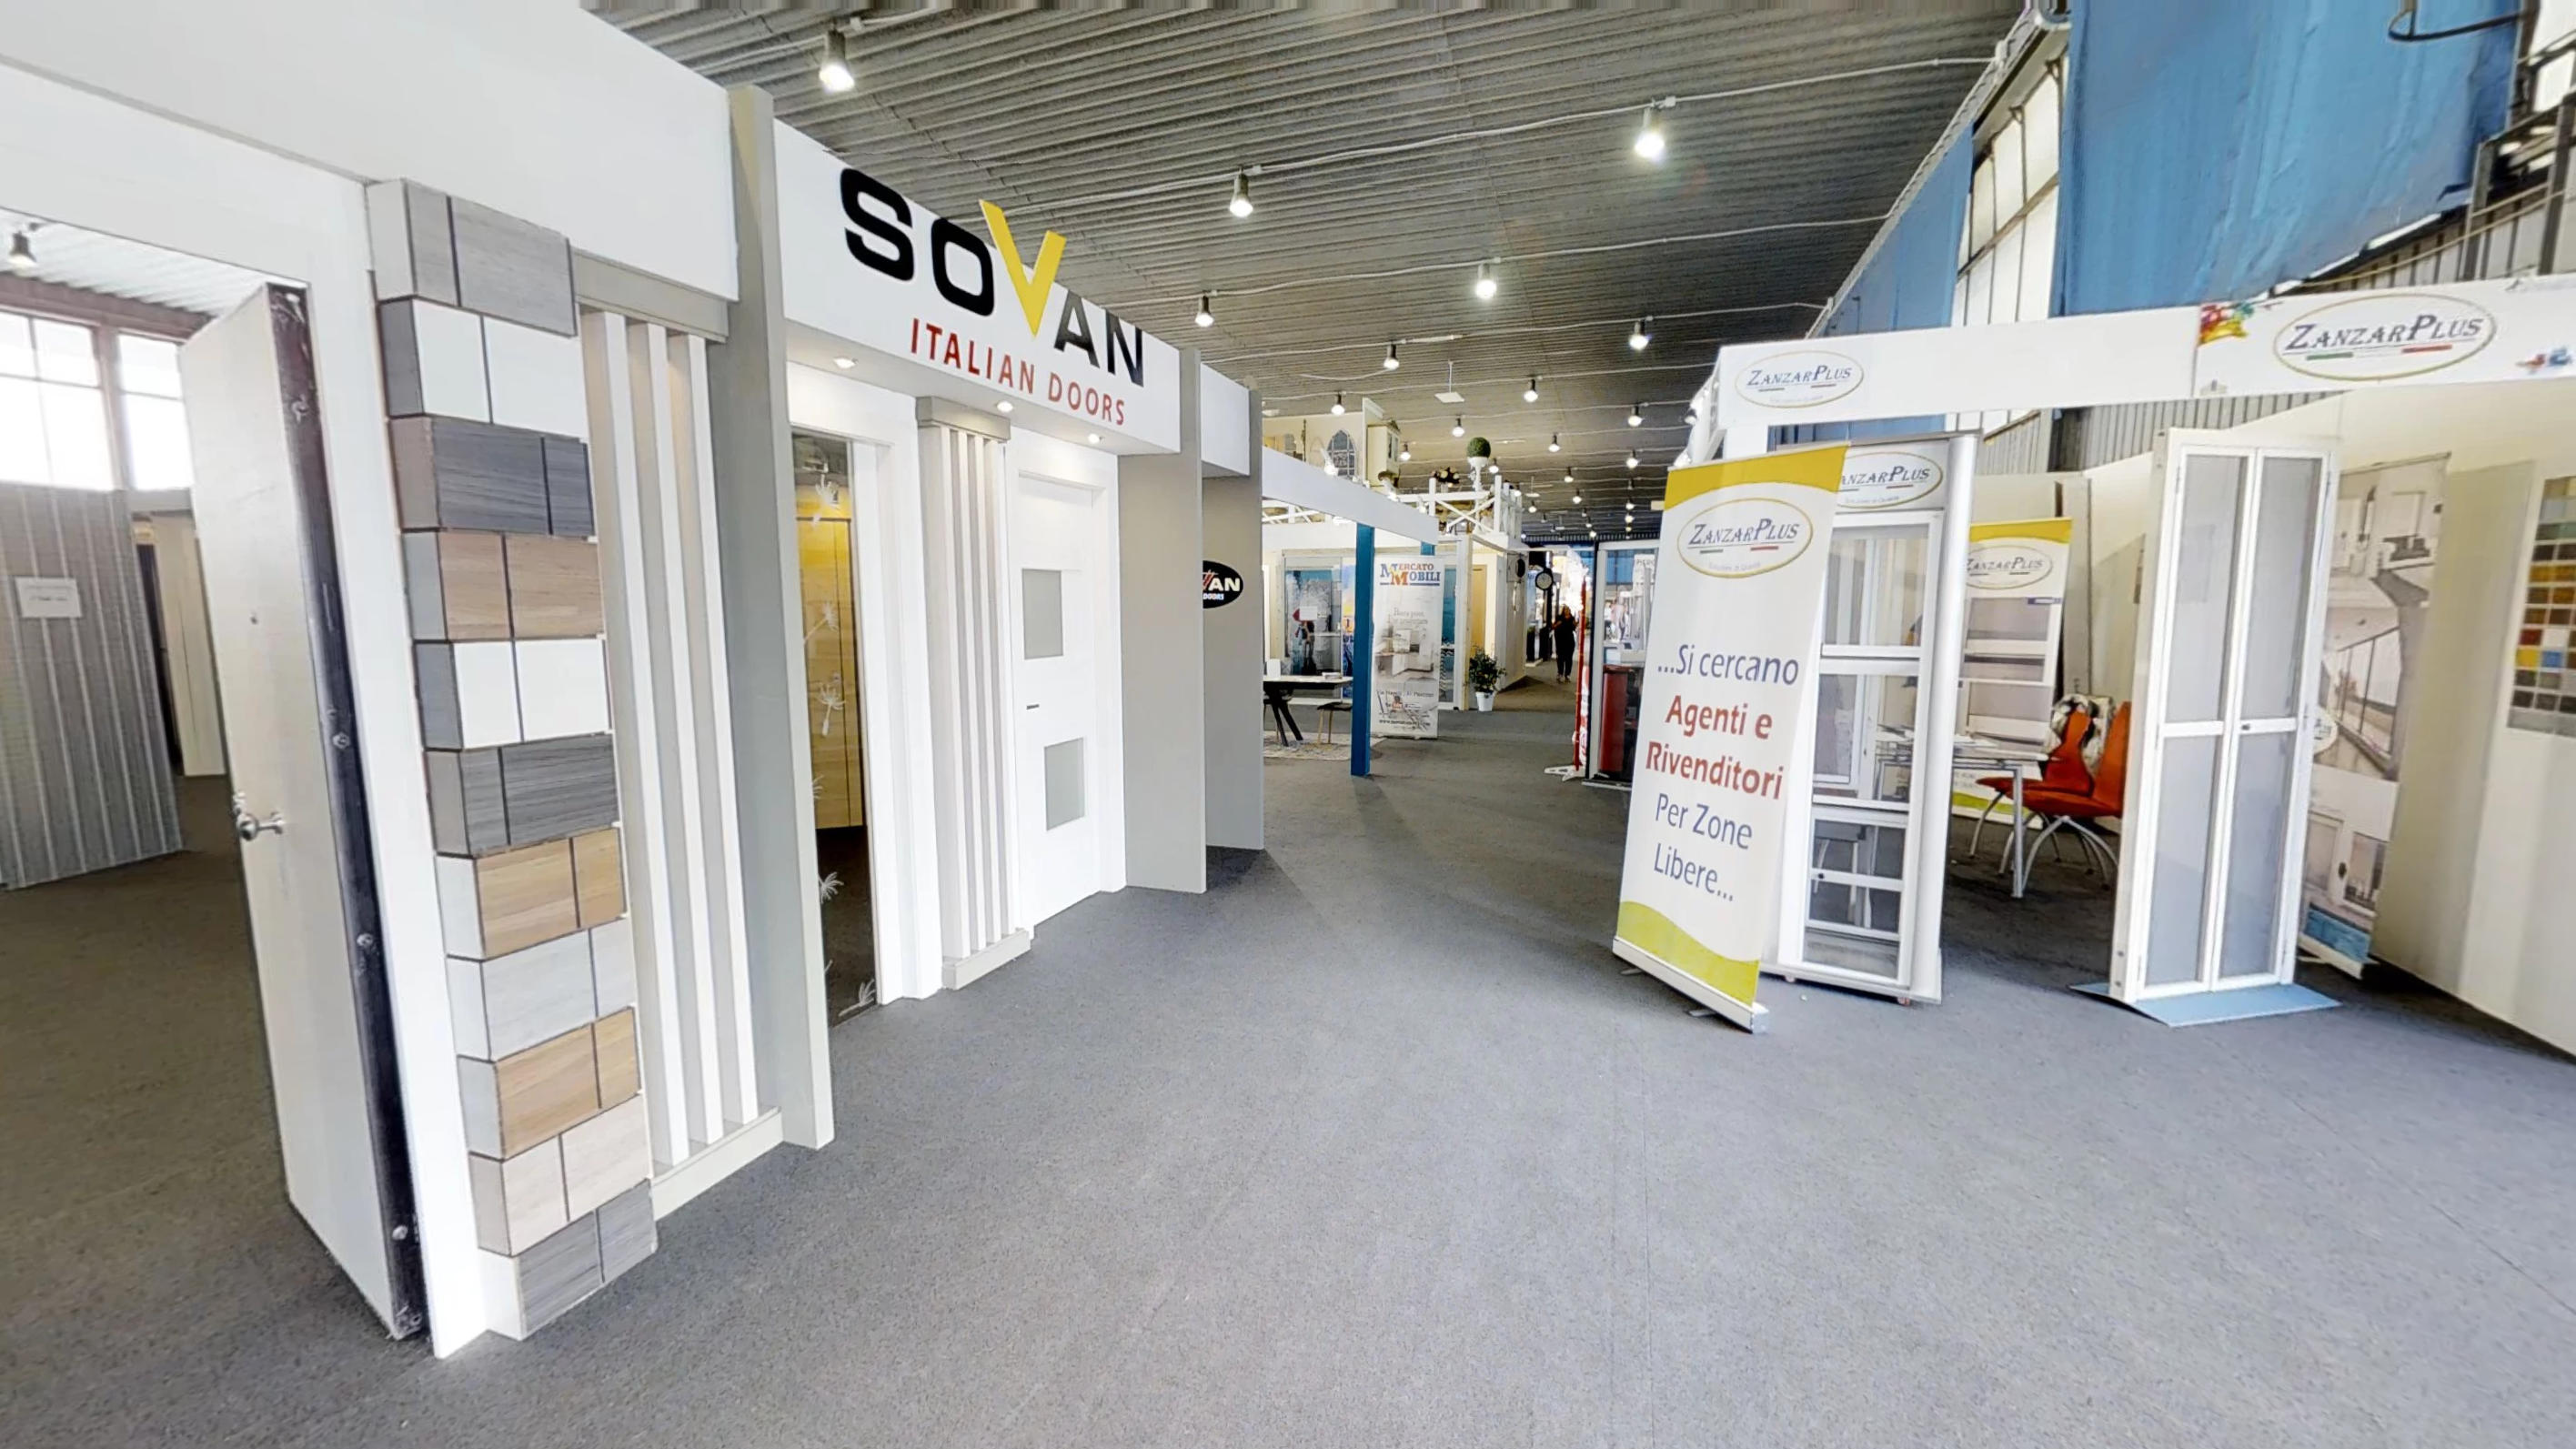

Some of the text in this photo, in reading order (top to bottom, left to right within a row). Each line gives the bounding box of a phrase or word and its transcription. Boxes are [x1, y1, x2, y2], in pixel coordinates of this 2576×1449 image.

[840, 167, 1144, 387] SOVAN
[911, 317, 1126, 426] ITALIAN DOORS
[1380, 563, 1434, 578] MERCATO
[1390, 571, 1442, 585] MOBILI
[1699, 652, 1799, 685] cercano
[1665, 695, 1773, 740] Agenti e
[1645, 740, 1784, 800] Rivenditori
[1655, 792, 1753, 850] Per Zone
[1654, 842, 1734, 901] Libere...
